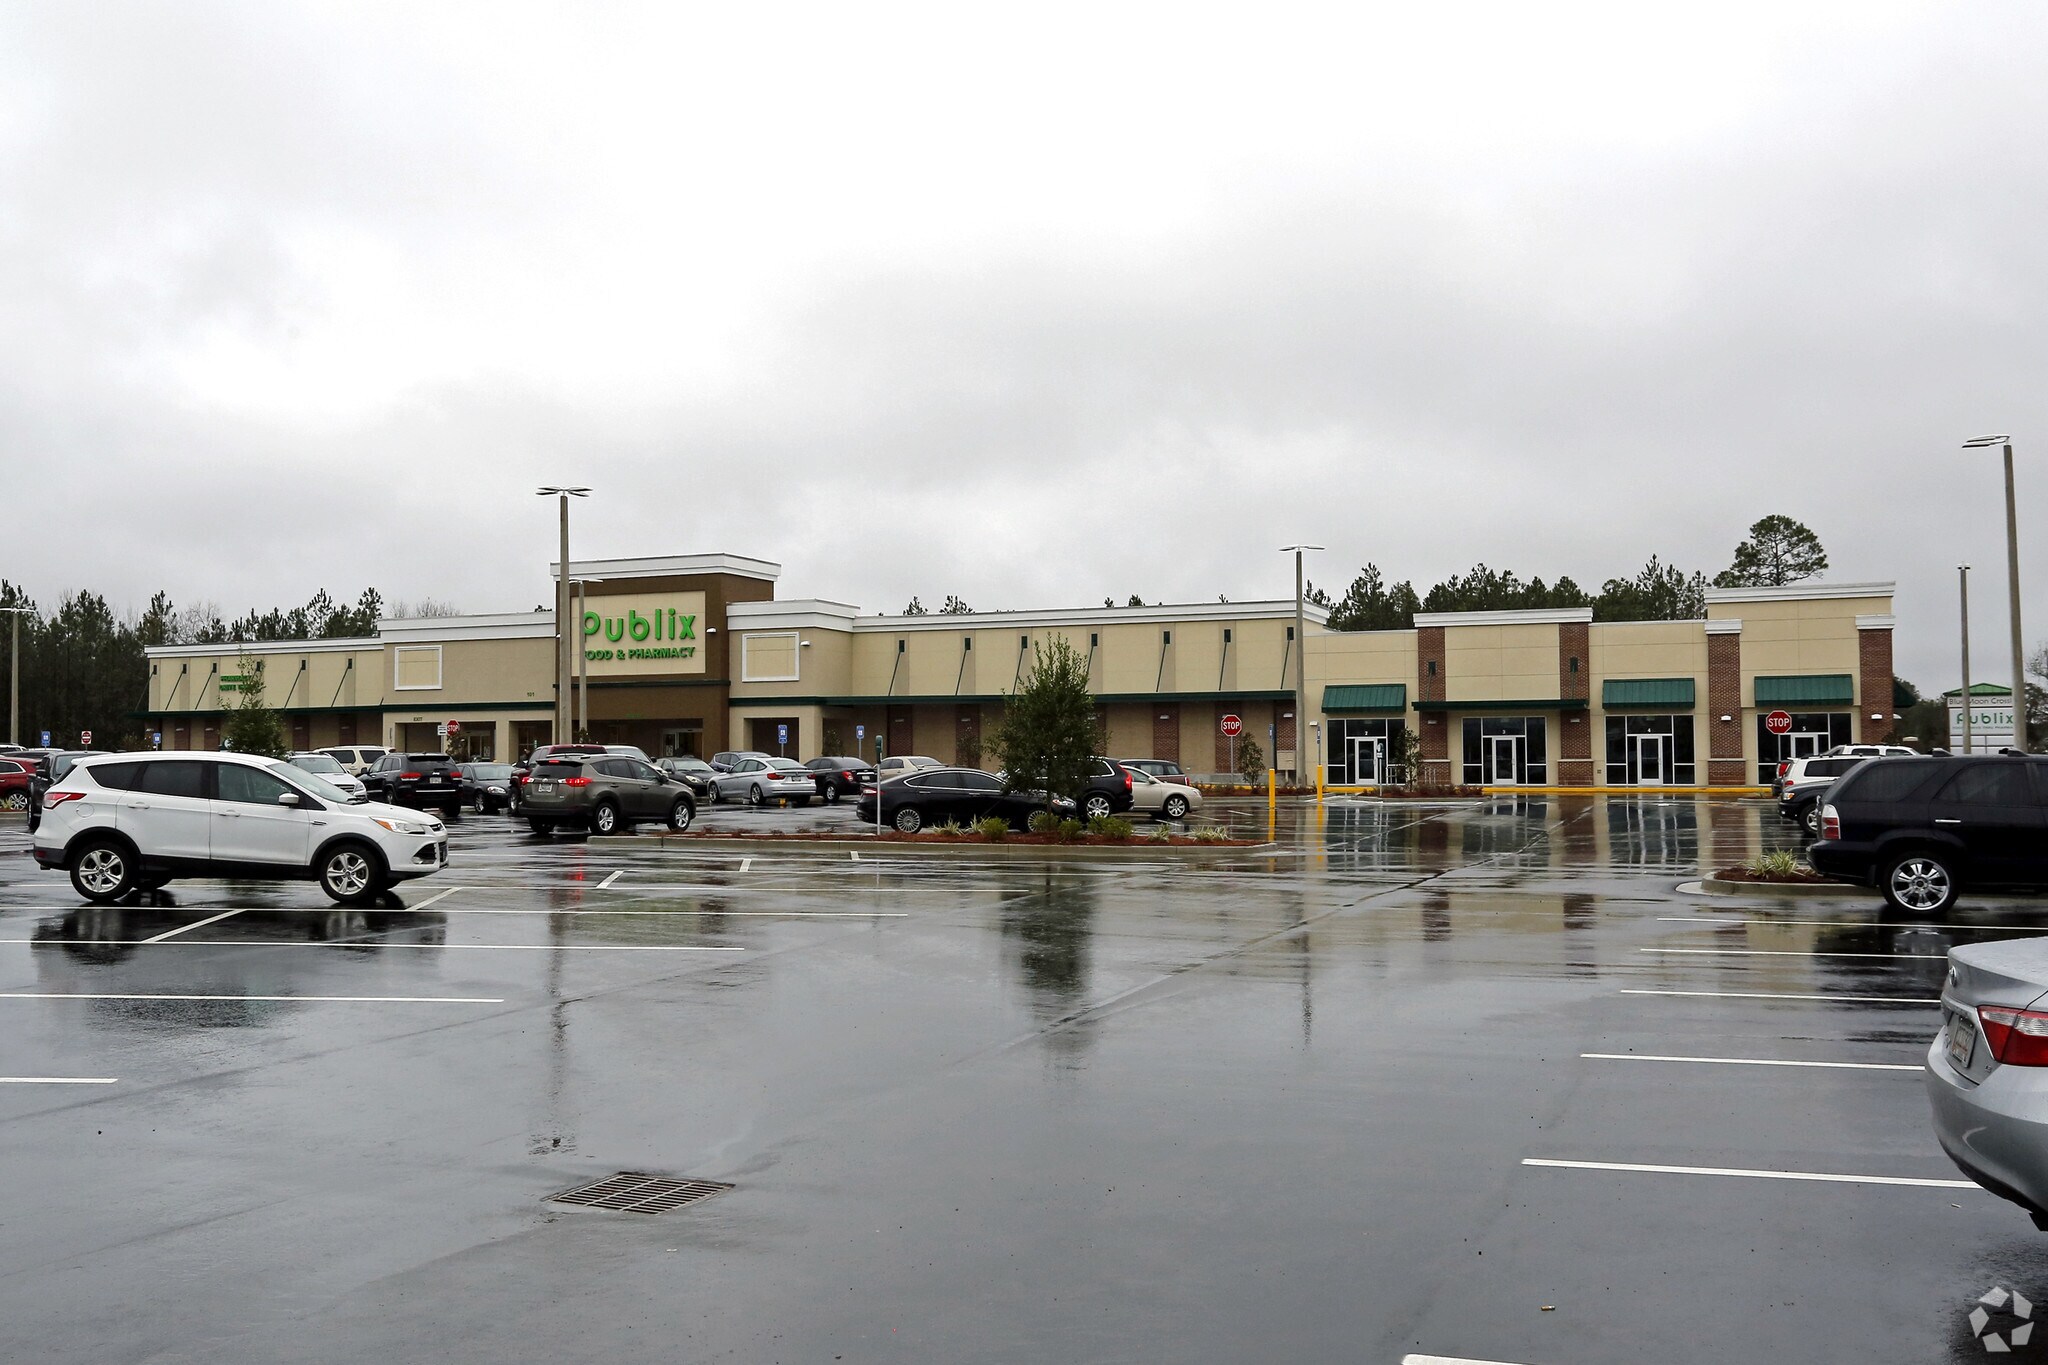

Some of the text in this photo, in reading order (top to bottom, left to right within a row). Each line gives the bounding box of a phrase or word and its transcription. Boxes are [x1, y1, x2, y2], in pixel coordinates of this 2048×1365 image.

[584, 608, 696, 642] Publix
[585, 646, 696, 660] OOD & PHARMACY
[1222, 721, 1241, 730] STOP
[1767, 717, 1790, 727] STOP
